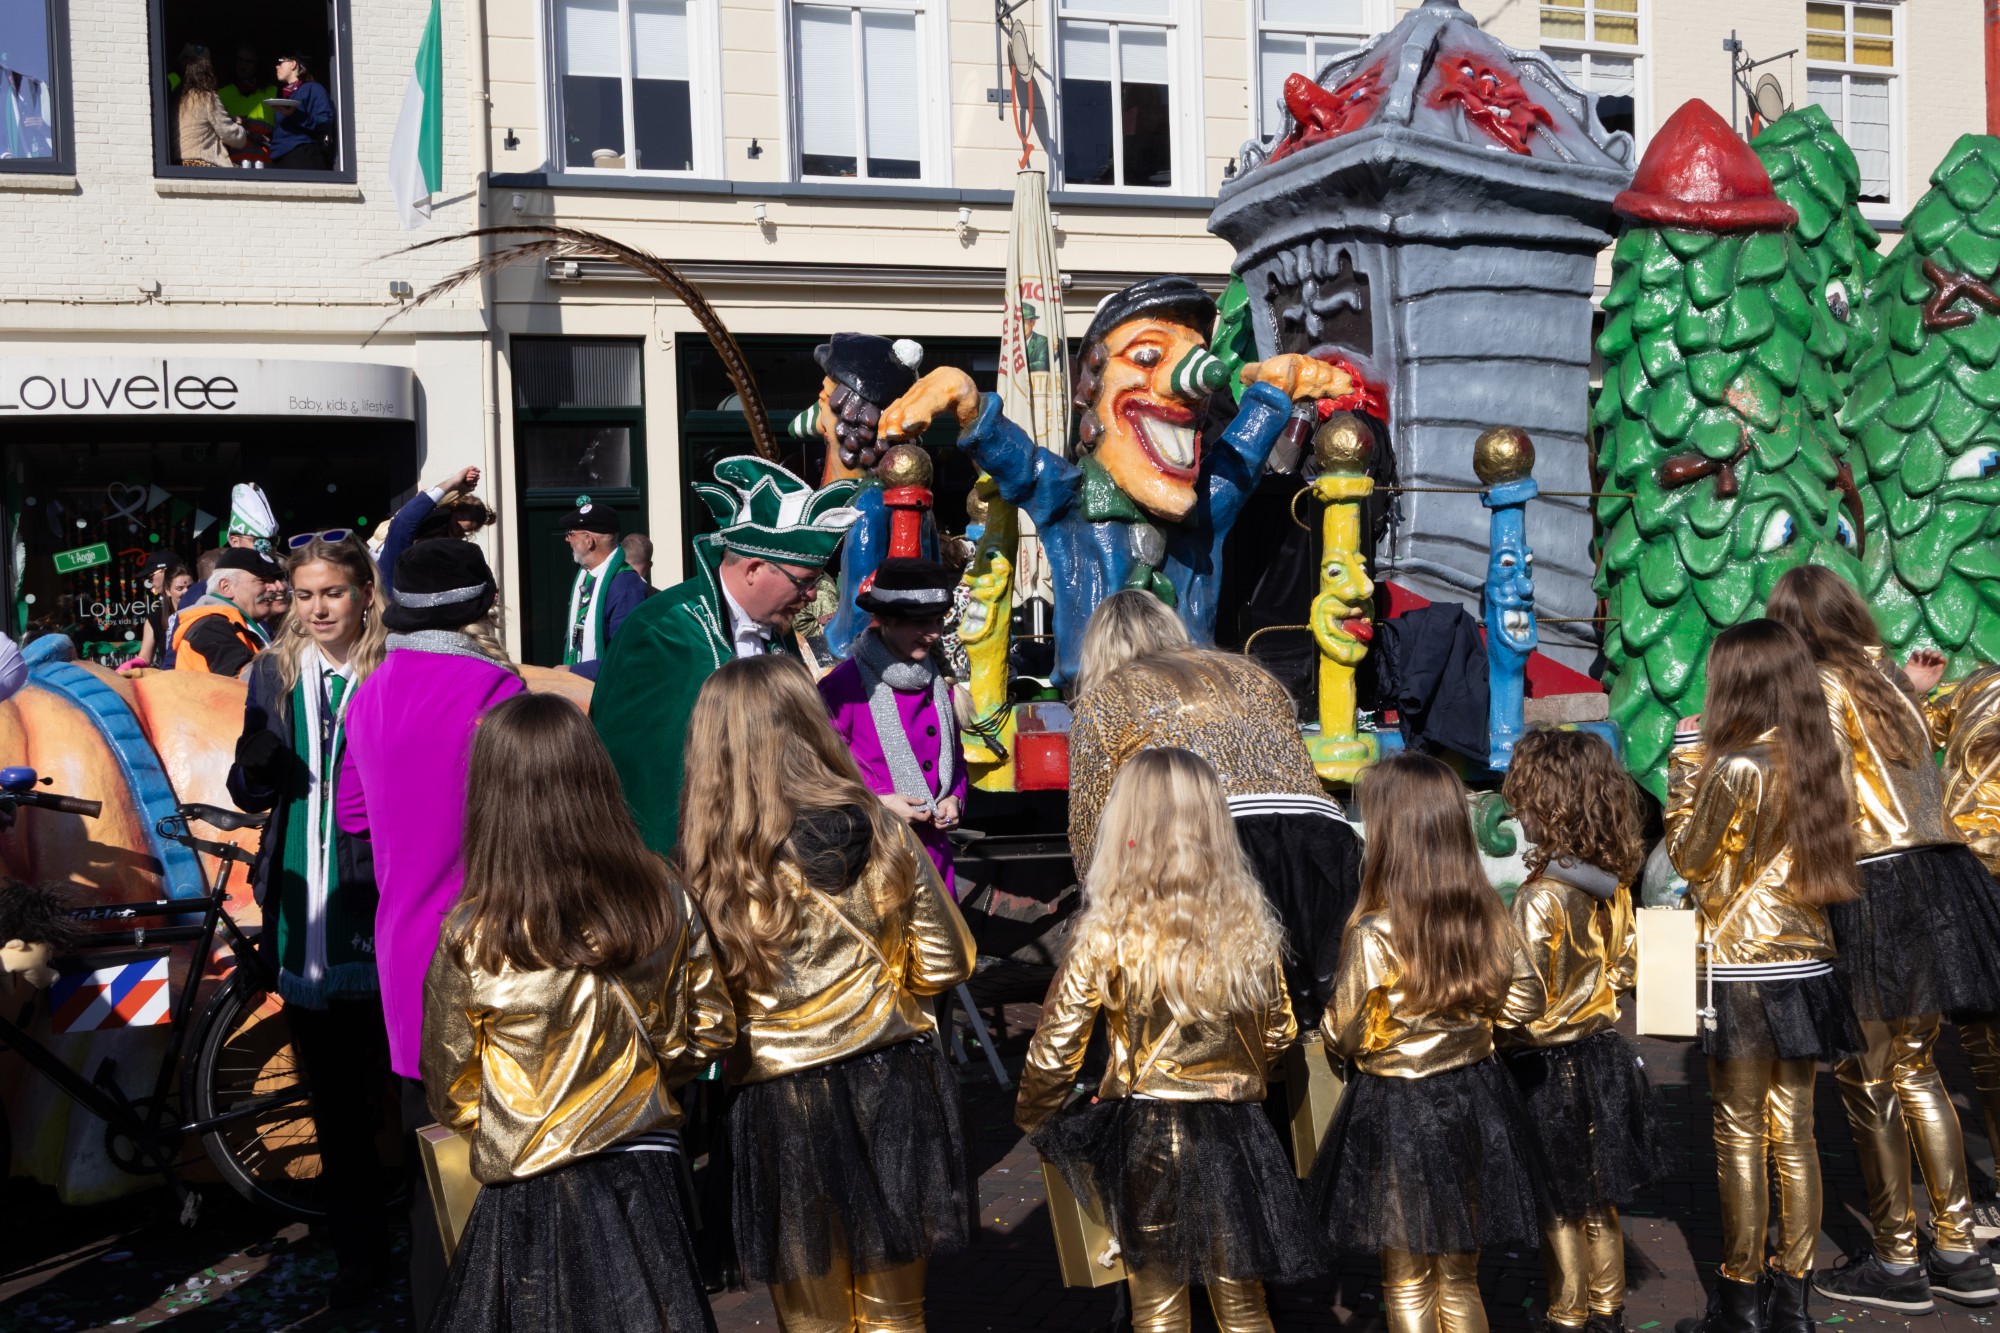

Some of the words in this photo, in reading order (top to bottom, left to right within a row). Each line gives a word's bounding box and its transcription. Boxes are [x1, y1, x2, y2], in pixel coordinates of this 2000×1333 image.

[289, 395, 323, 413] Baby,
[326, 397, 348, 411] kids
[350, 401, 359, 414] &
